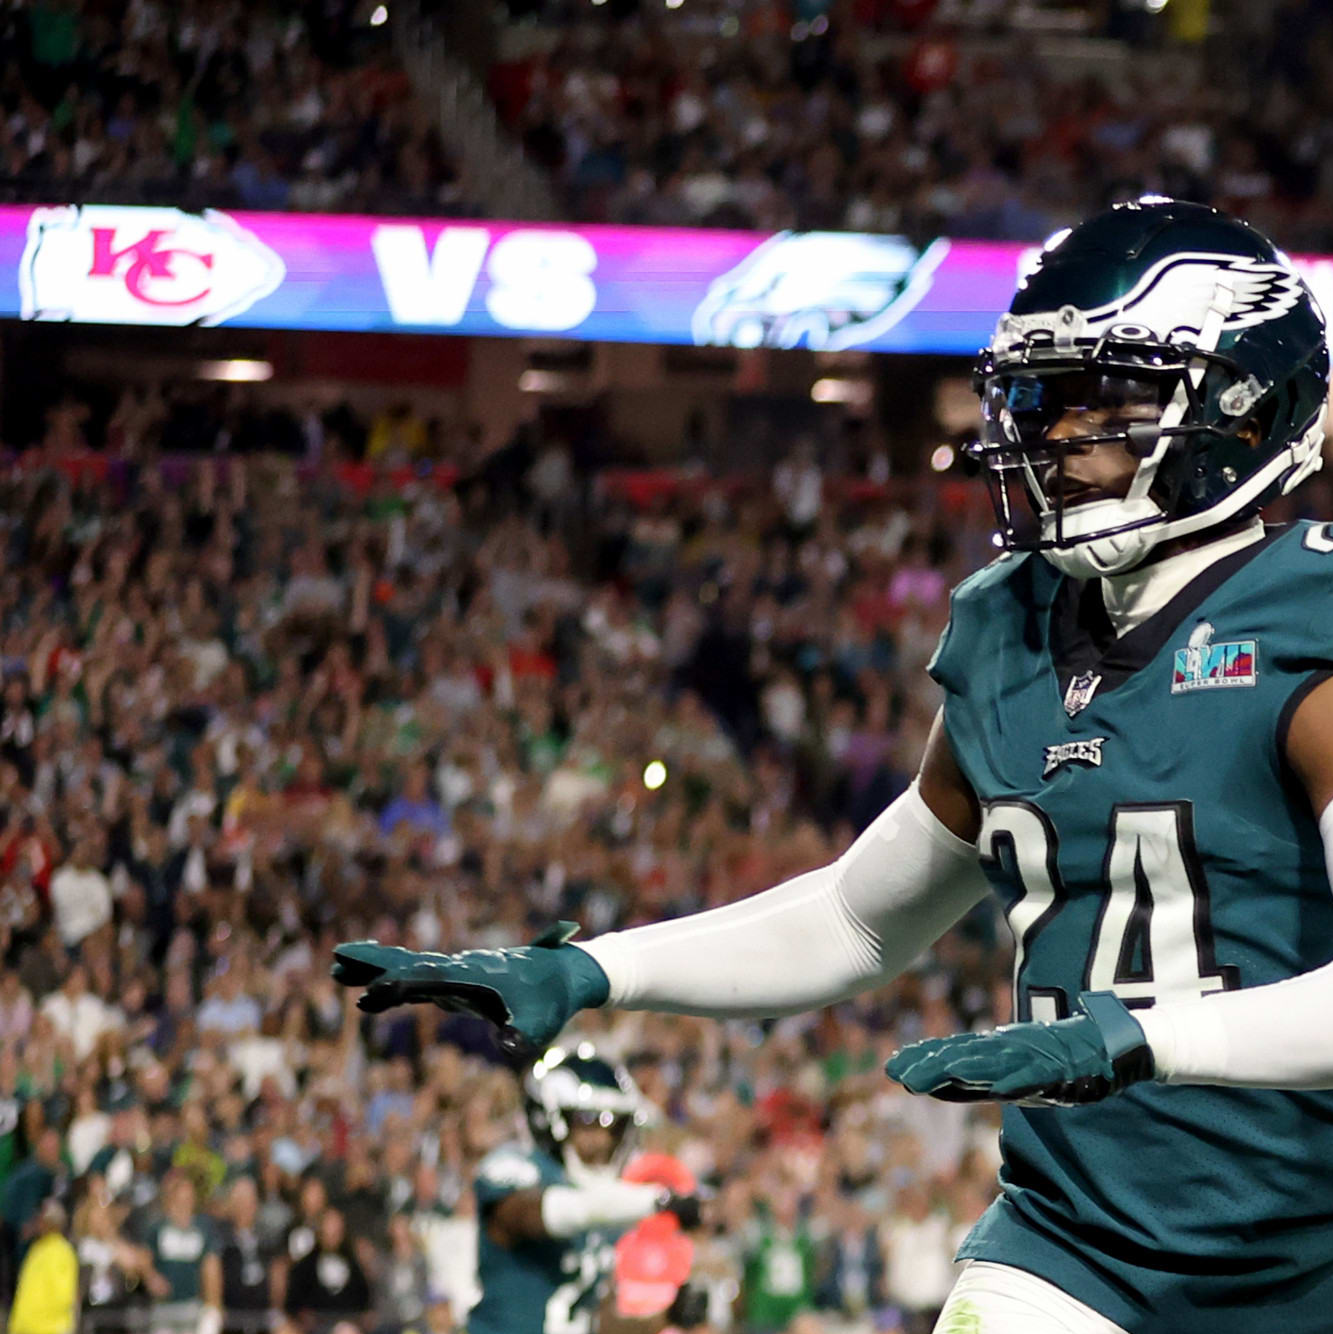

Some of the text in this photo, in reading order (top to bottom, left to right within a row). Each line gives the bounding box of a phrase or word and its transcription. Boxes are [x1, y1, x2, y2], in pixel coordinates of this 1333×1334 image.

[88, 226, 215, 307] KC
[373, 223, 598, 331] VS
[978, 797, 1241, 1023] 24
